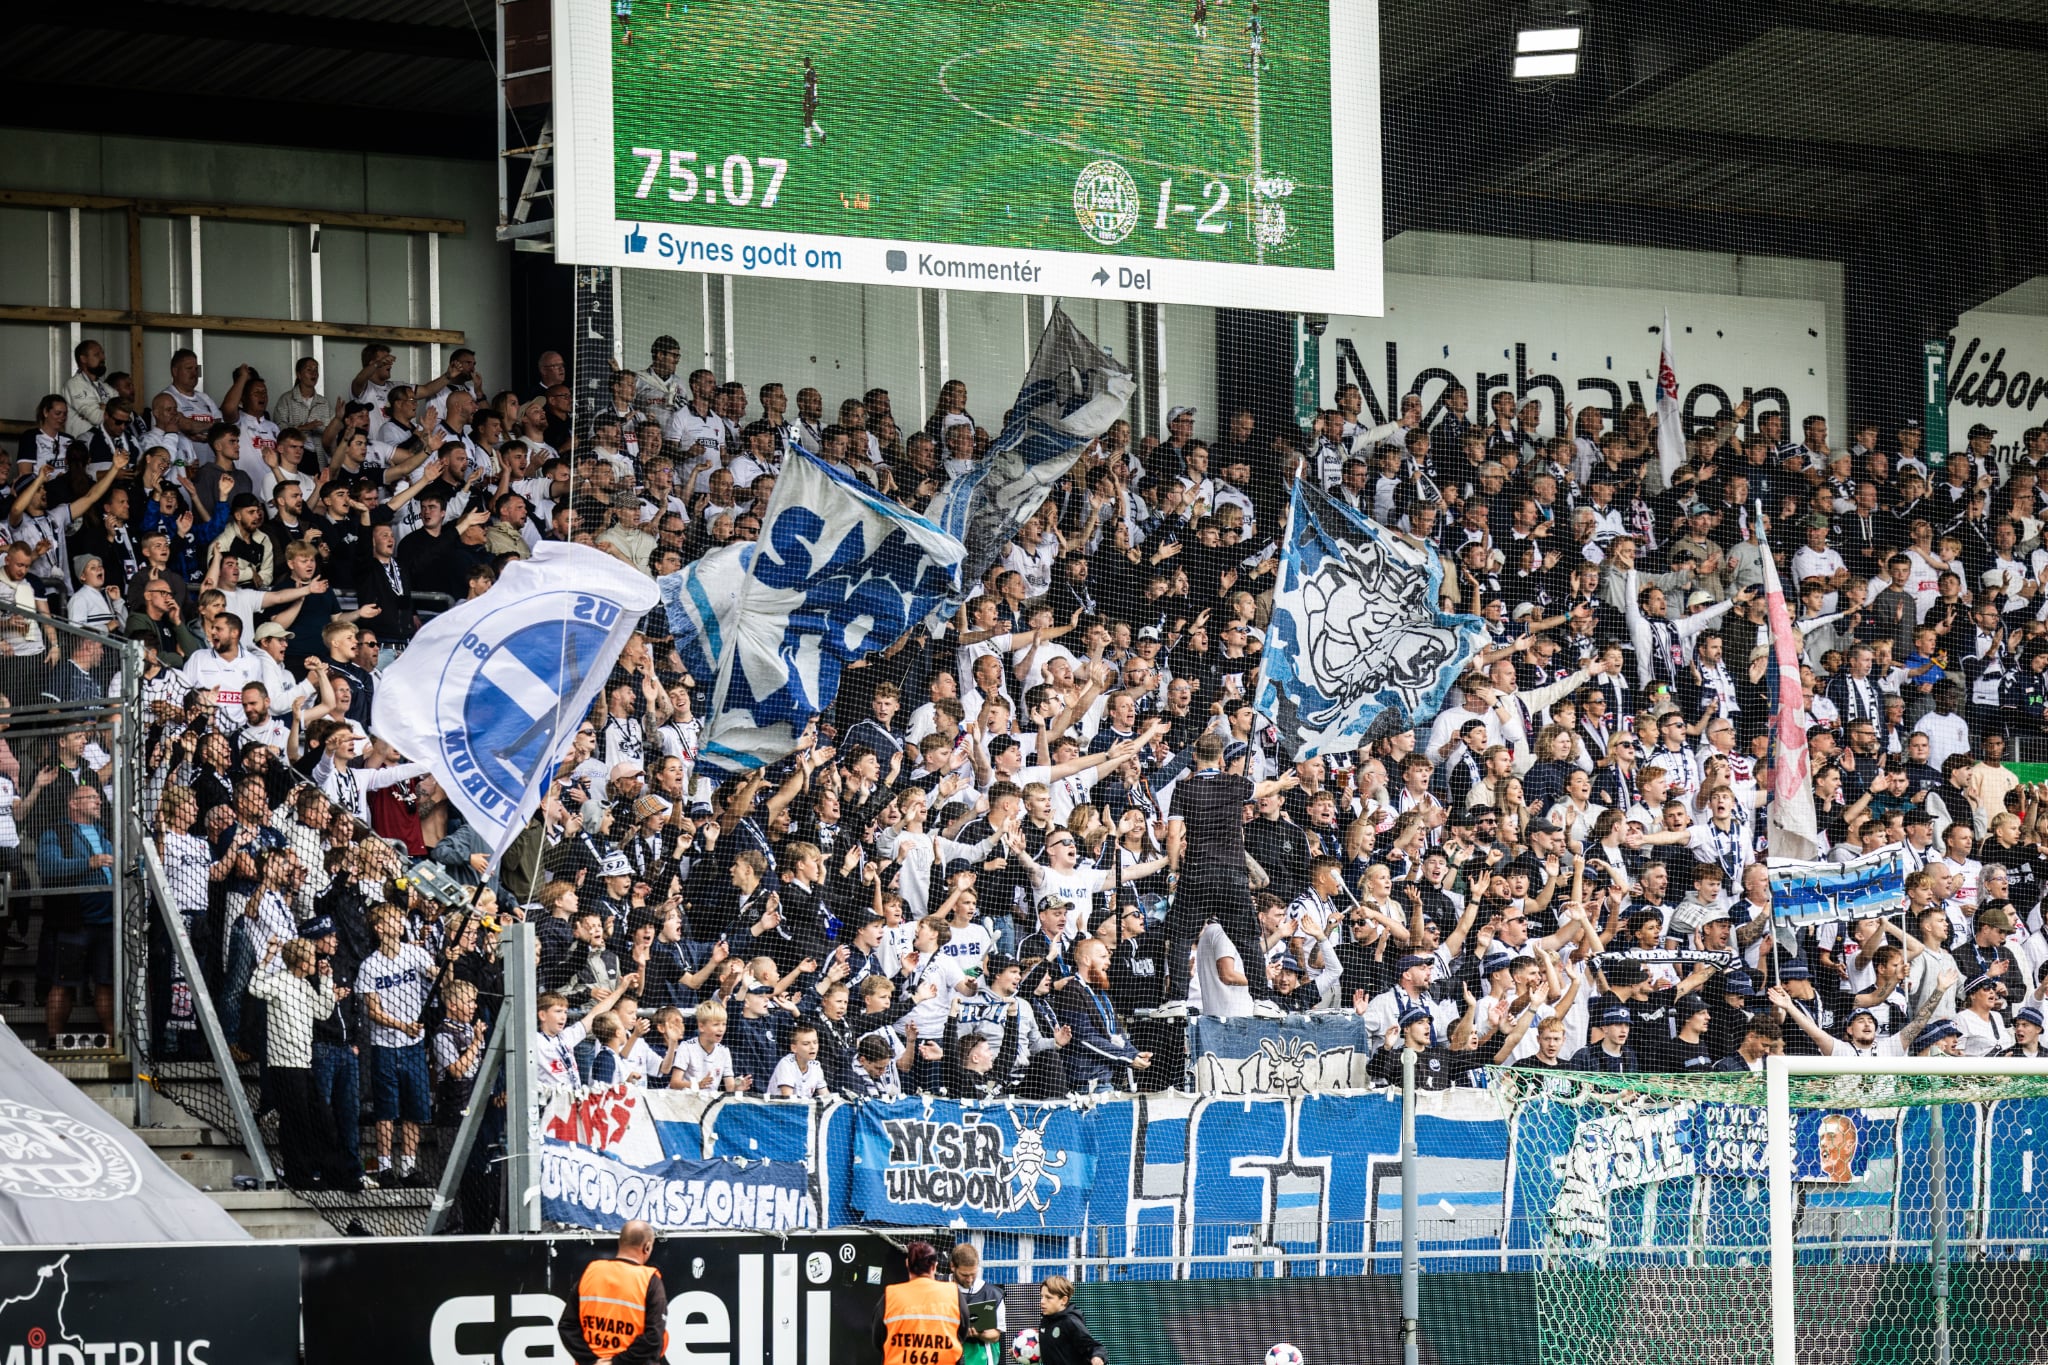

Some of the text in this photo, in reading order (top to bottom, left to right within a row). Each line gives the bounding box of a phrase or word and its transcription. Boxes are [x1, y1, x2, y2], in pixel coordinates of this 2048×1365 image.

[632, 147, 788, 208] 75:07
[1153, 178, 1230, 233] 1-2
[658, 232, 842, 270] Synes godt om
[918, 252, 1042, 285] Kommentér
[1117, 265, 1152, 290] Del
[1947, 336, 2048, 411] Vibor
[430, 1251, 832, 1365] caelli
[582, 1315, 635, 1336] STEWARD
[588, 1330, 621, 1349] 1660
[890, 1333, 954, 1350] STEWARD
[902, 1349, 939, 1365] 1664
